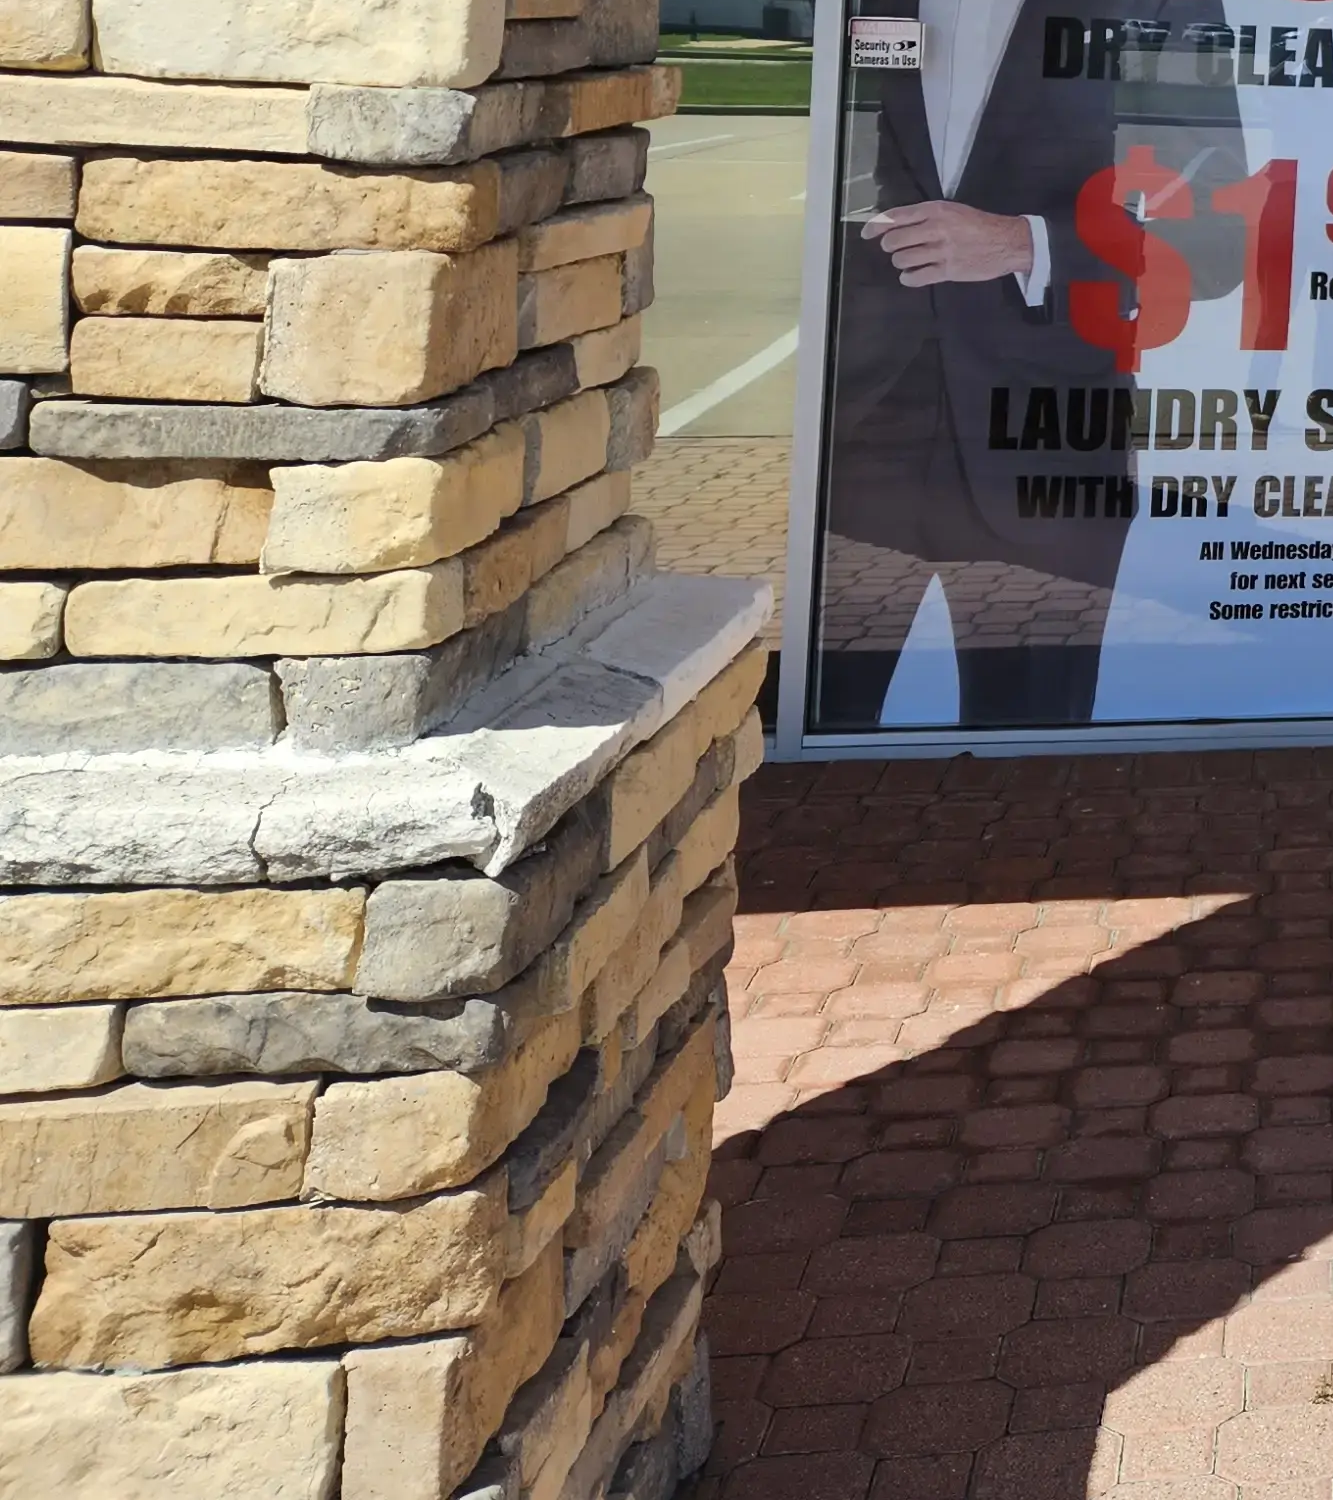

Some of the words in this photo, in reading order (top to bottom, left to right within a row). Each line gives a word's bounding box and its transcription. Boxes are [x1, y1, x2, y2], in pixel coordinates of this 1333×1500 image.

[855, 39, 890, 53] Security
[1043, 17, 1171, 82] DRY
[855, 53, 889, 65] Cameras
[902, 55, 916, 65] Use
[988, 387, 1282, 451] LAUNDRY
[1016, 475, 1134, 519] WITH
[1150, 475, 1237, 518] DRY
[1199, 542, 1223, 560] All
[1230, 571, 1259, 590] for
[1264, 572, 1306, 589] next
[1209, 601, 1263, 620] Some
